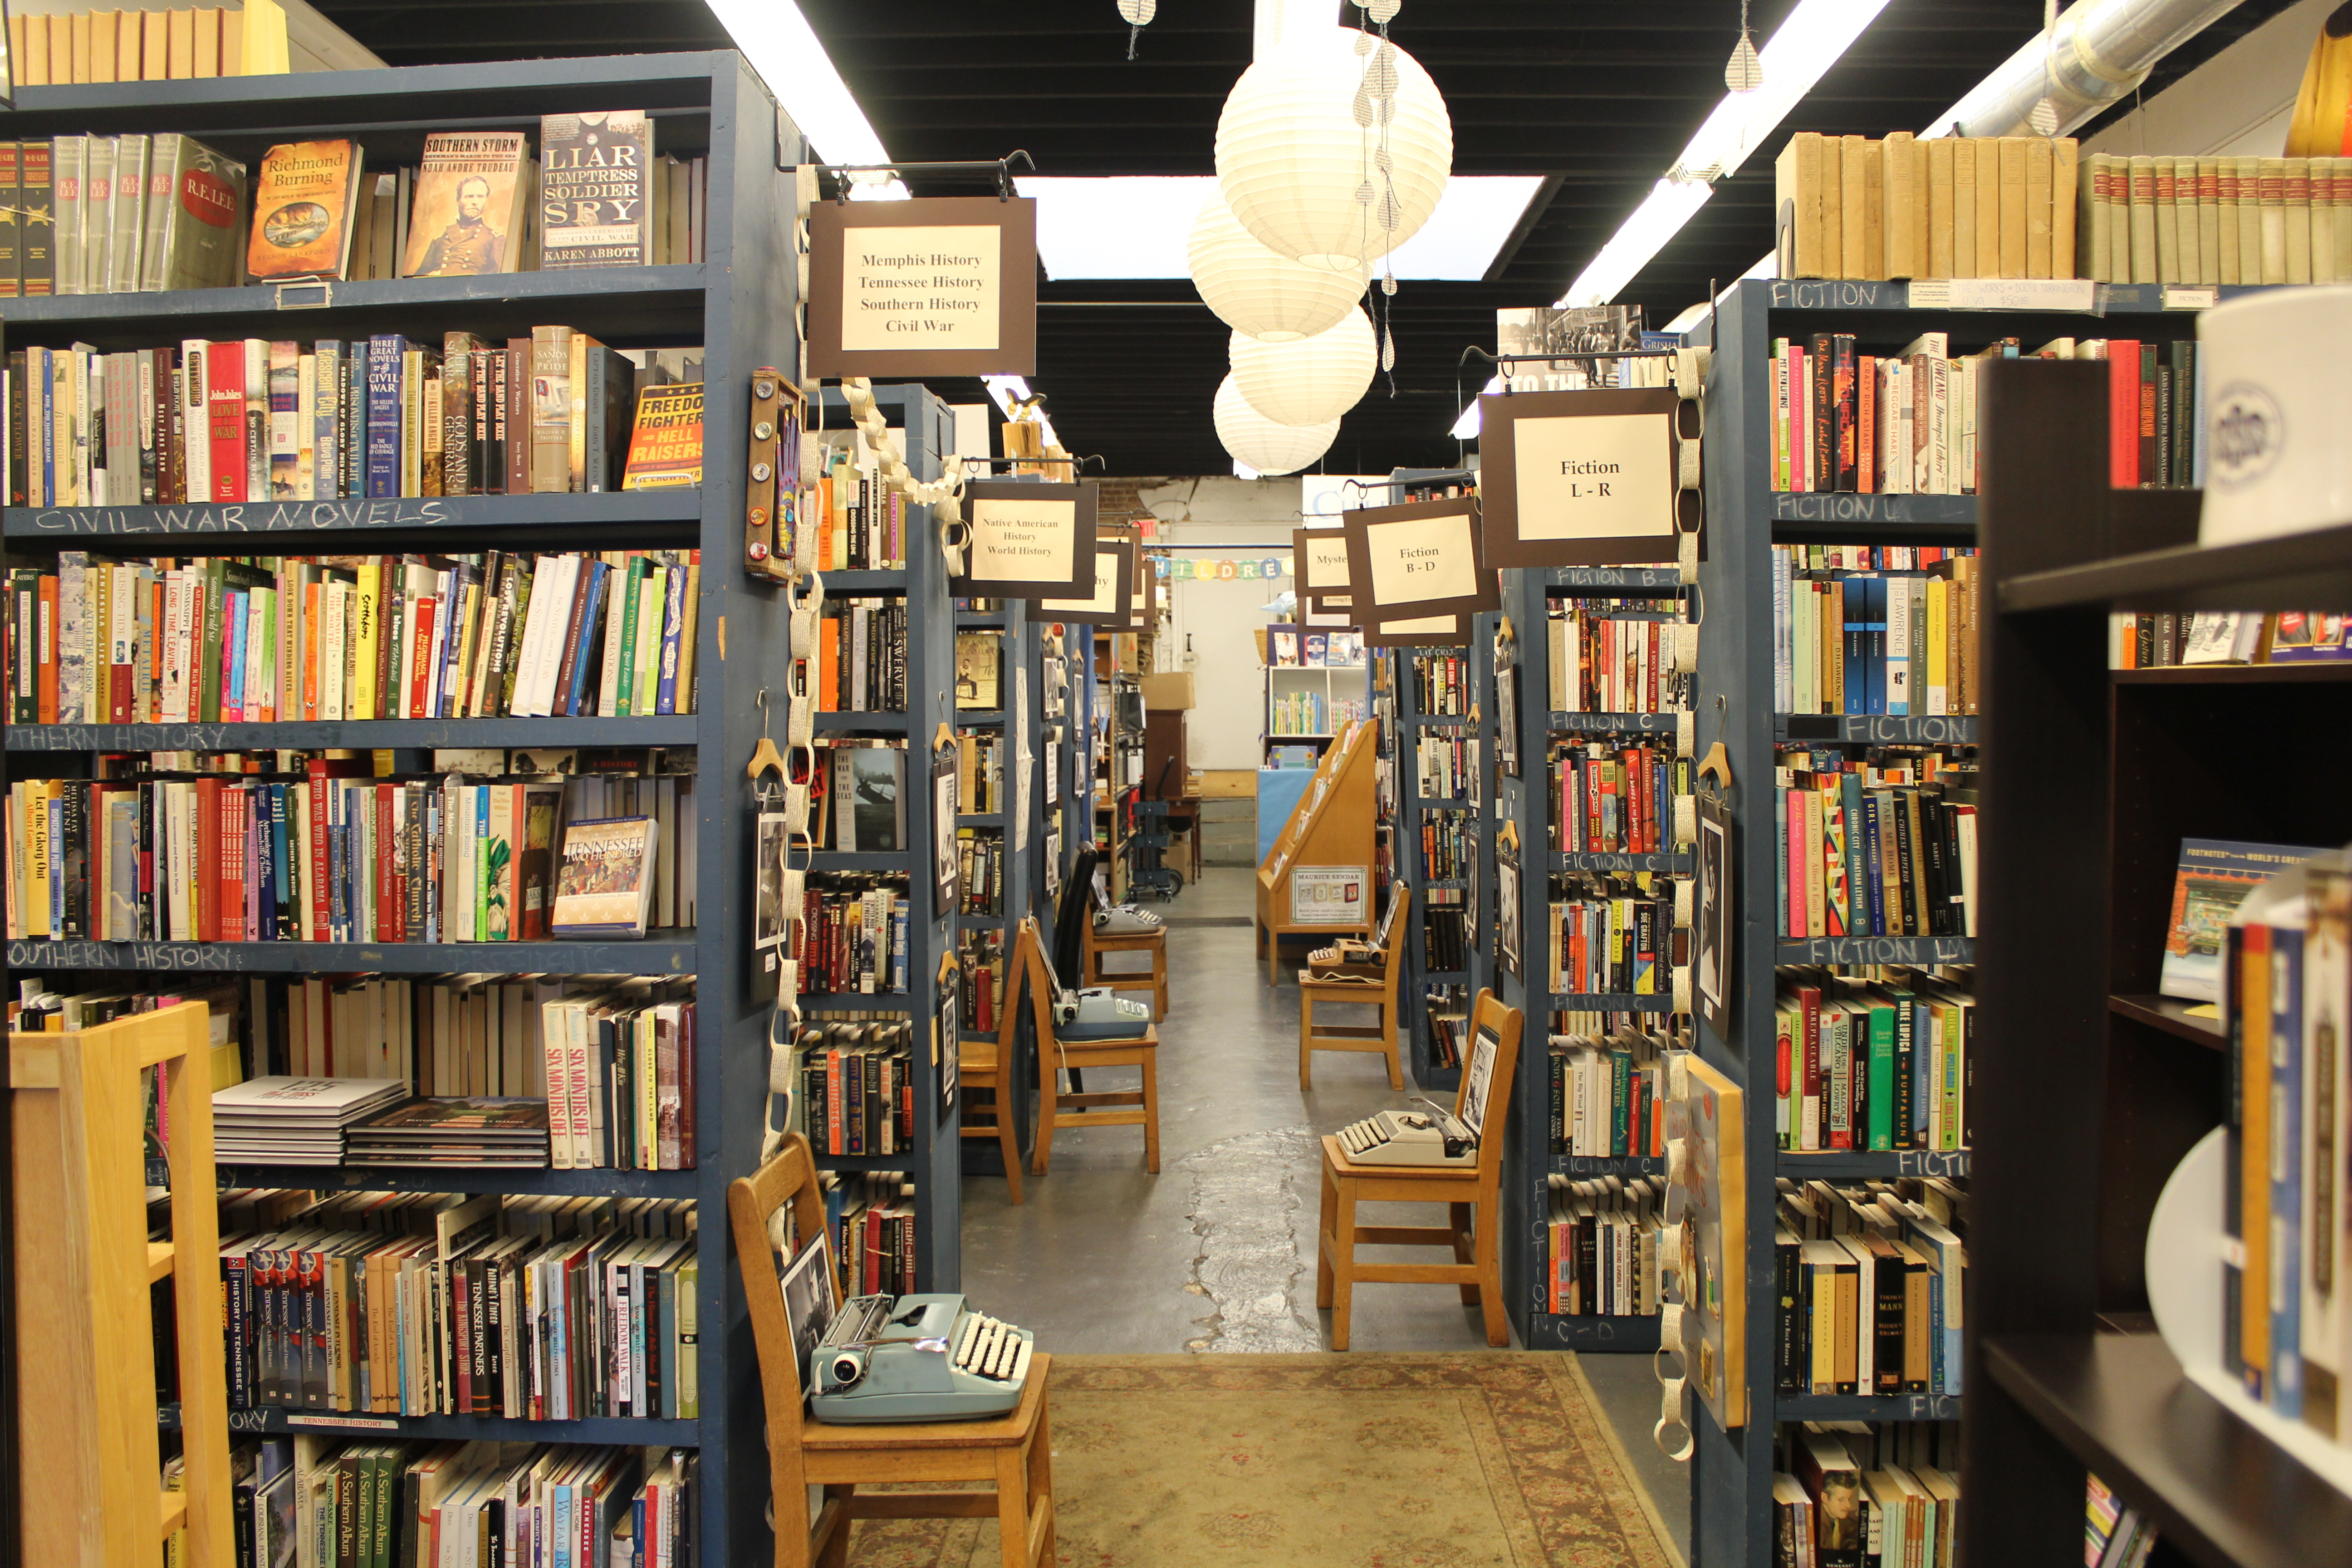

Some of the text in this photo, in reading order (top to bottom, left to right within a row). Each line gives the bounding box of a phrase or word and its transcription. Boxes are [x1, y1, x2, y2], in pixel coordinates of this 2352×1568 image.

[426, 138, 518, 152] SOUTHERN STORM
[268, 154, 343, 172] Richmond
[545, 146, 637, 170] LIAR
[422, 162, 514, 173] NOAH ANDRE TRUDEAU
[274, 170, 333, 186] Burning
[546, 169, 638, 185] TEMPTRESS
[545, 184, 639, 201] SOLDIER
[544, 199, 639, 224] SPY
[256, 248, 330, 260] NELSON LANKFORD
[545, 247, 639, 261] KAREN ABBOTT
[862, 254, 982, 270] Memphis History
[858, 276, 984, 291] Tennessee History
[1771, 284, 1877, 308] FICTION
[861, 298, 980, 313] Southern History
[886, 319, 954, 332] Civil War
[370, 340, 397, 348] THREE
[370, 347, 397, 356] GREAT
[1642, 340, 1679, 350] GRISHA
[369, 354, 400, 363] NOVELS
[537, 350, 568, 360] SANDS
[537, 362, 568, 371] PRIDE
[190, 353, 201, 405] GETTYSBURG
[369, 374, 399, 383] CIVIL
[211, 390, 241, 400] John Jakes
[370, 382, 397, 392] WAR
[212, 403, 240, 417] LOVE
[642, 396, 703, 414] FREEDO
[1839, 350, 1851, 474] THE THIRD ANGEL
[1930, 340, 1946, 473] THE LOWLAND Jhumpa Lahiri
[214, 426, 238, 440] WAR
[657, 429, 694, 443] HELL
[1560, 461, 1620, 475] Fiction
[1571, 484, 1582, 497] L
[1598, 483, 1612, 496] R
[1777, 495, 1874, 519] FICTION
[36, 501, 449, 532] CIVIL WAR NOVELS
[983, 519, 1058, 528] Native American
[1003, 532, 1037, 542] History
[987, 546, 1052, 557] World History
[1400, 546, 1440, 559] Fiction
[1406, 564, 1414, 573] B
[1426, 561, 1436, 571] D
[1558, 570, 1625, 584] FICTION
[361, 594, 371, 640] Scottsboro
[1894, 598, 1905, 654] LAWRENCE
[893, 639, 904, 690] SWERVE
[1551, 714, 1652, 729] FICTION C
[1846, 716, 1969, 742] FICTION
[115, 726, 227, 750] HISTORY
[1850, 809, 1859, 835] CHRONIC
[34, 796, 47, 881] Let the Glory Out
[313, 779, 325, 904] WHO WAS WHO IN ALABAMA
[567, 836, 644, 854] TENNESSEE
[565, 847, 642, 863] TWO HUNDRED
[1563, 854, 1659, 870] FICTION C
[1853, 855, 1862, 886] JONATHAN
[1855, 887, 1863, 909] LETHEM
[134, 943, 229, 968] HISTORY
[1810, 940, 1917, 964] FICTION
[1555, 996, 1625, 1010] FICTION
[1899, 1001, 1911, 1052] MIKE LUPICA
[547, 1048, 569, 1139] SIX MONTHS OFF
[1558, 1158, 1650, 1172] FICTION C
[232, 1280, 240, 1319] HISTORY
[234, 1323, 240, 1333] IN
[472, 1281, 485, 1376] TENNESSEE PARTNERS
[619, 1300, 630, 1373] FREEDOM WALK
[342, 1470, 353, 1557] A Southern Album
